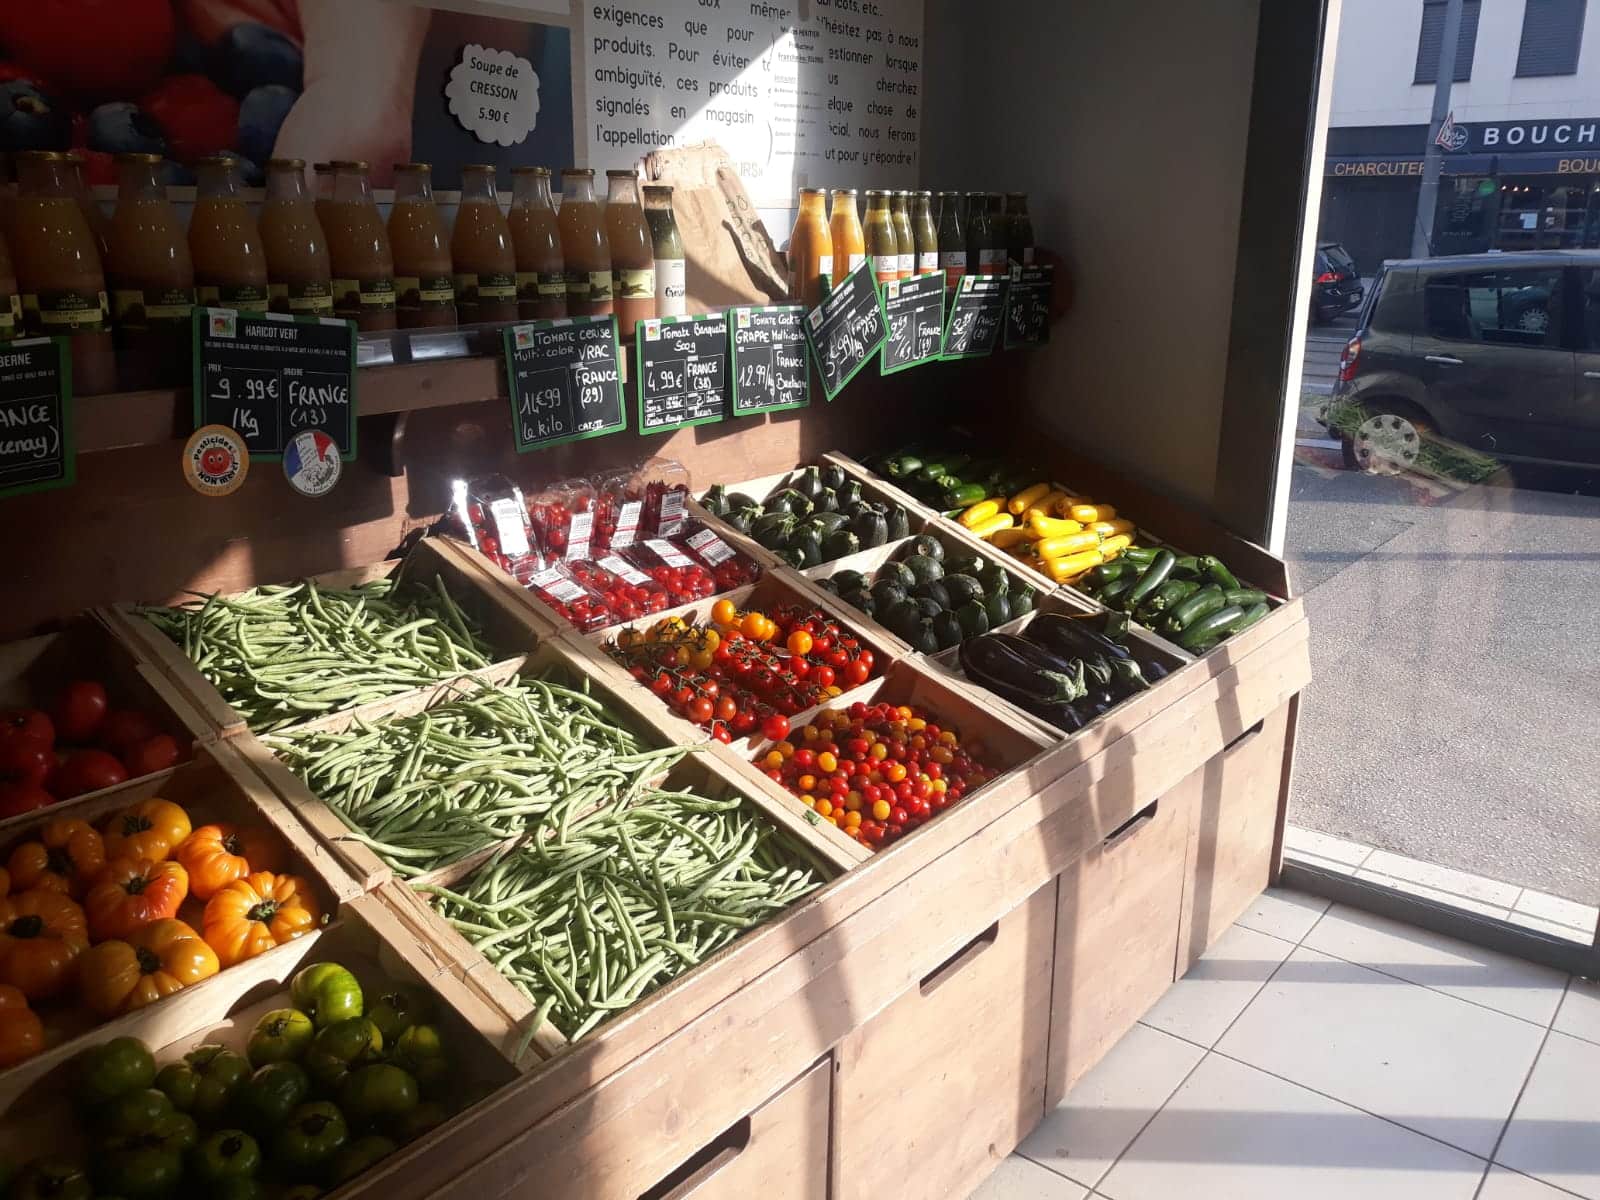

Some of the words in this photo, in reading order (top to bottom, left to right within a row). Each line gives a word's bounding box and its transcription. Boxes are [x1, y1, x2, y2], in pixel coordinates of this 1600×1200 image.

[593, 5, 664, 29] exigences
[685, 20, 708, 37] que
[727, 26, 755, 42] pour
[866, 29, 882, 43] pas
[888, 29, 894, 44] à
[898, 35, 919, 48] nous
[594, 37, 656, 57] produits.
[668, 42, 699, 63] Pour
[712, 50, 750, 69] éviter
[886, 52, 919, 73] lorsque
[470, 57, 503, 76] Soupe
[505, 64, 519, 78] de
[470, 80, 518, 101] CRESSON
[676, 77, 699, 92] ces
[709, 80, 759, 97] produits
[876, 76, 918, 96] cherchez
[479, 107, 501, 122] 5.90
[504, 112, 510, 124] €
[596, 98, 651, 117] signalés
[671, 105, 687, 120] en
[706, 108, 755, 127] magasin
[867, 102, 894, 117] chose
[906, 104, 917, 119] de
[596, 124, 676, 148] l'appellation
[858, 127, 880, 138] nous
[887, 126, 917, 143] ferons
[1483, 124, 1596, 146] BOUCH
[837, 150, 858, 164] pour
[245, 325, 277, 338] HARICOT
[280, 328, 299, 340] VERT
[736, 329, 770, 344] GRAPPE
[578, 344, 609, 360] VRAC
[687, 361, 718, 378] FRANCE
[288, 380, 349, 406] FRANCE
[290, 407, 328, 428] (13)
